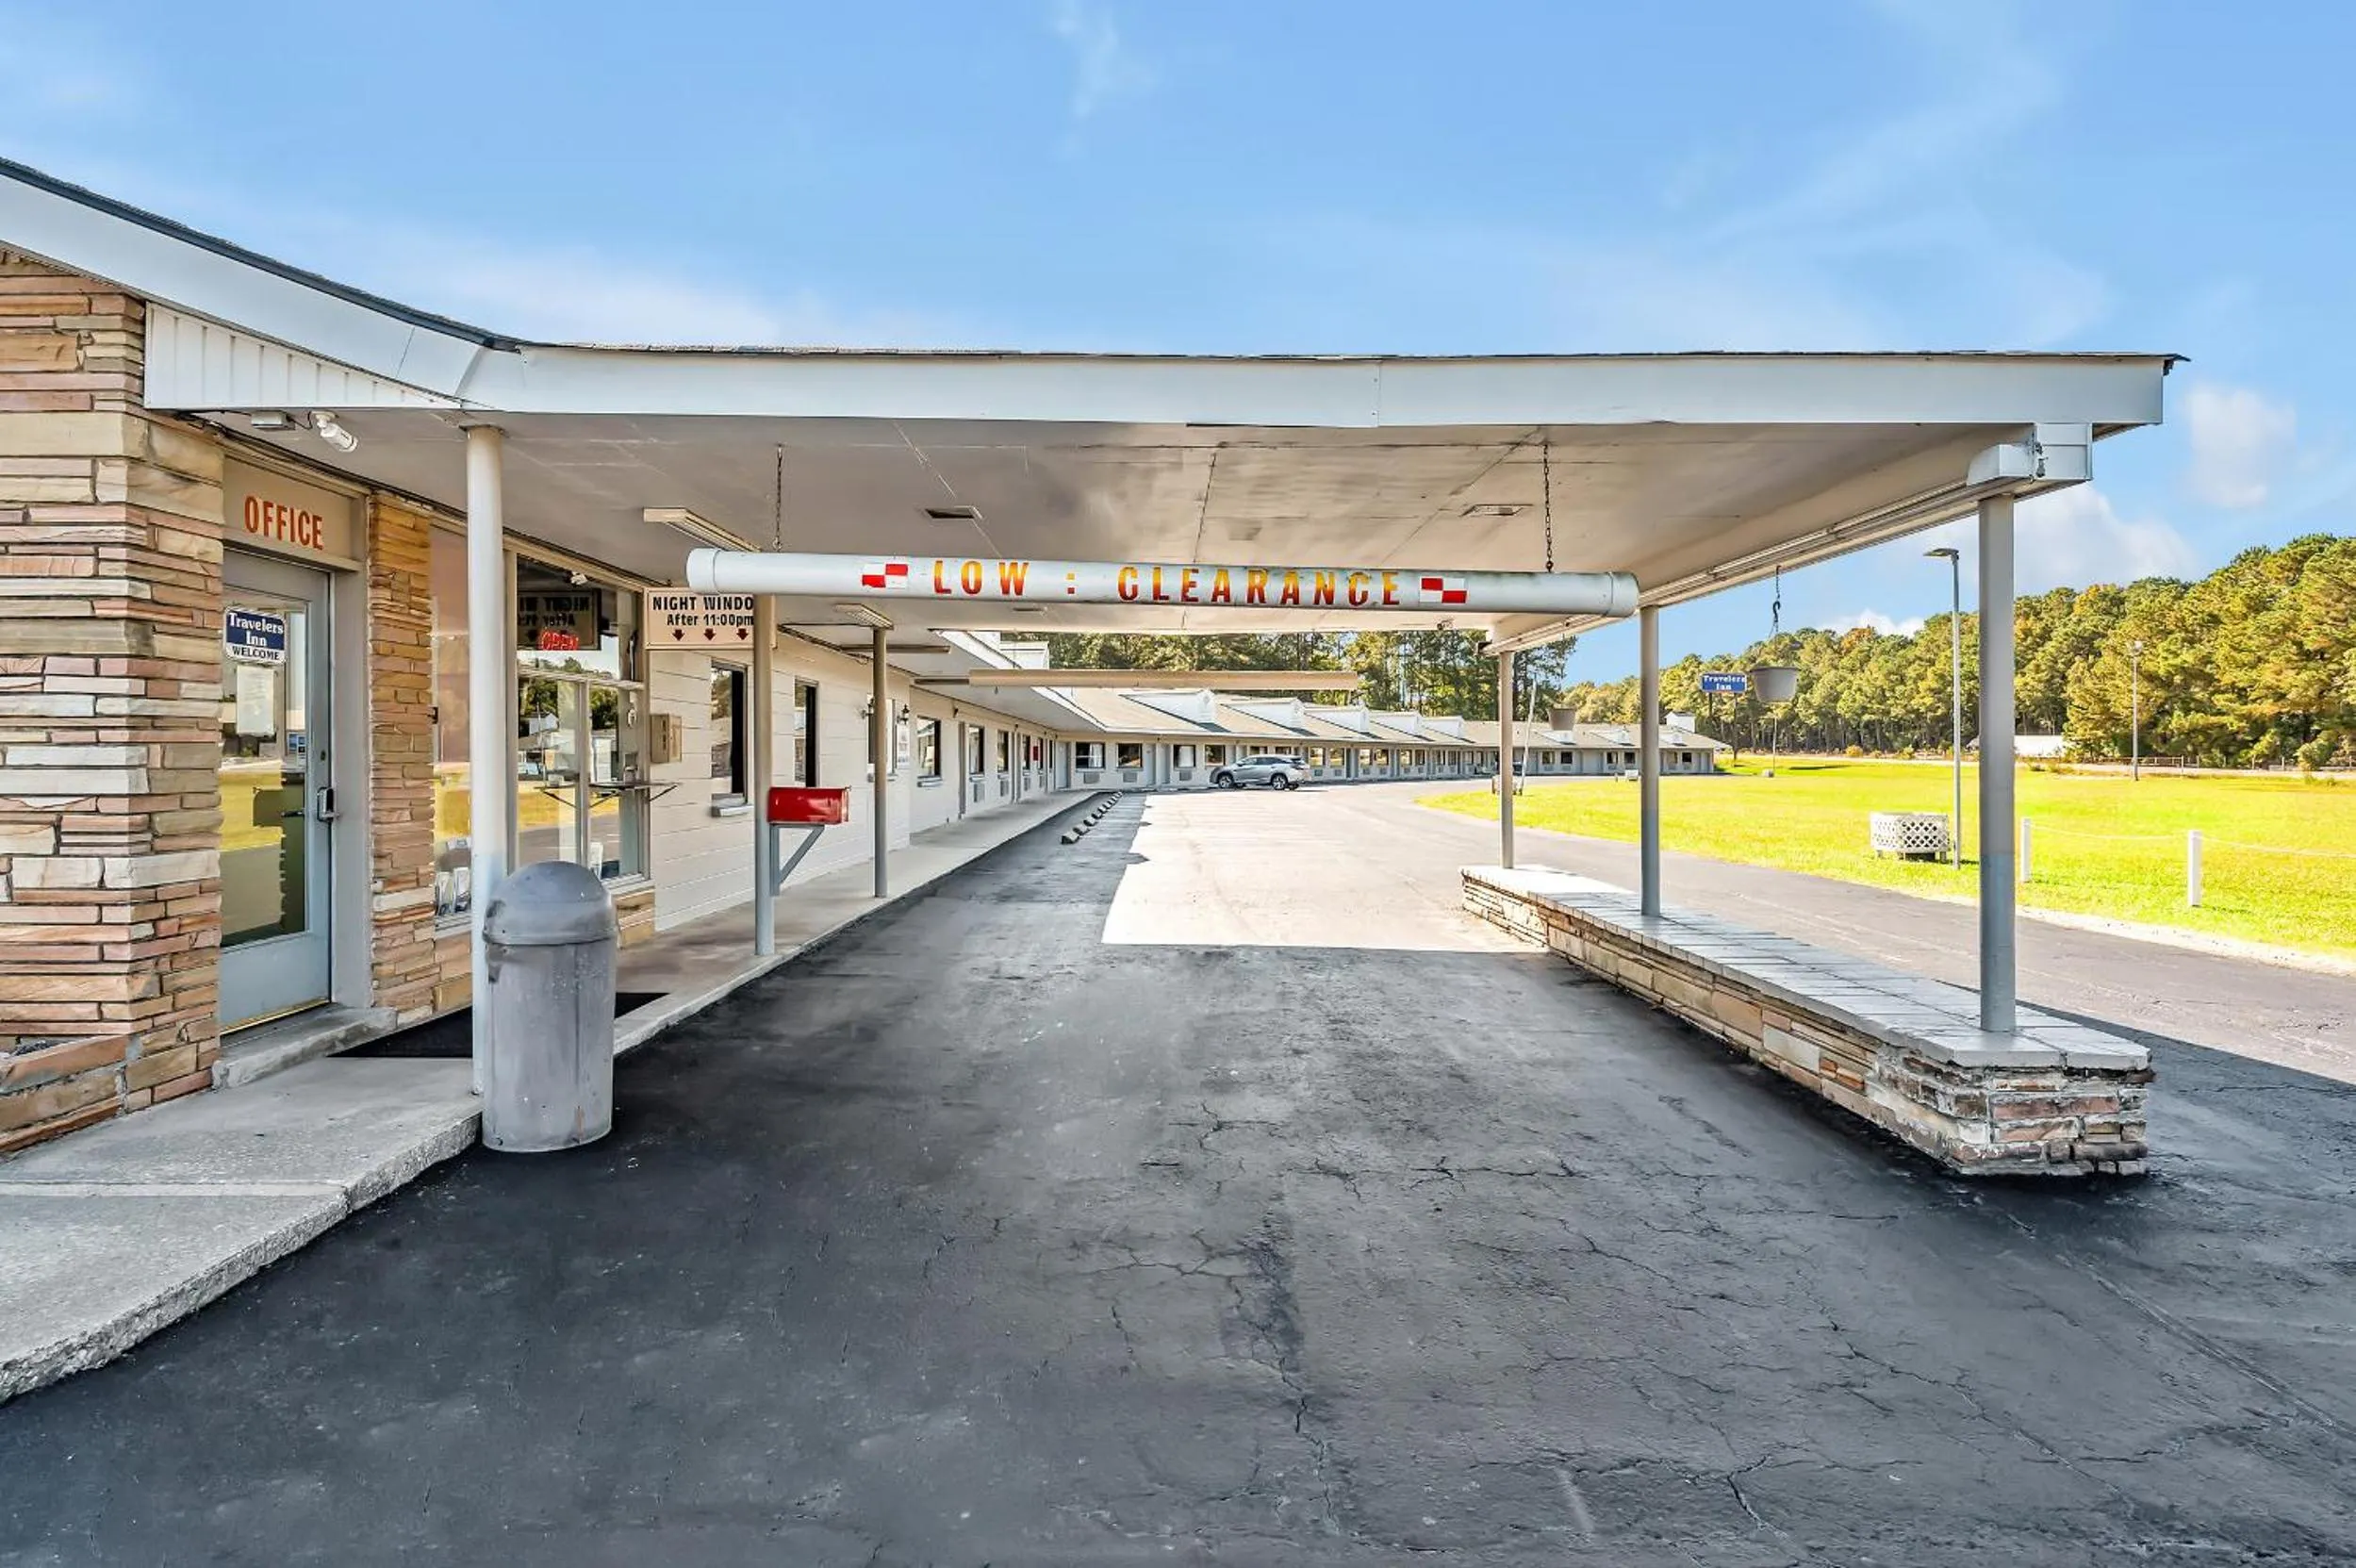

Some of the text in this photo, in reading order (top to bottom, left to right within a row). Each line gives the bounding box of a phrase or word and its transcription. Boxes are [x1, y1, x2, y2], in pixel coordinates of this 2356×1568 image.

[243, 495, 324, 551] OFFICE
[933, 560, 1030, 596] LOW
[1116, 566, 1401, 606] CLEARANCE
[652, 596, 754, 611] NIGHT WINDO
[228, 612, 284, 635] Travelers
[667, 613, 754, 628] After 11:00pm
[246, 630, 267, 647] Inn
[232, 645, 279, 660] WELCOME
